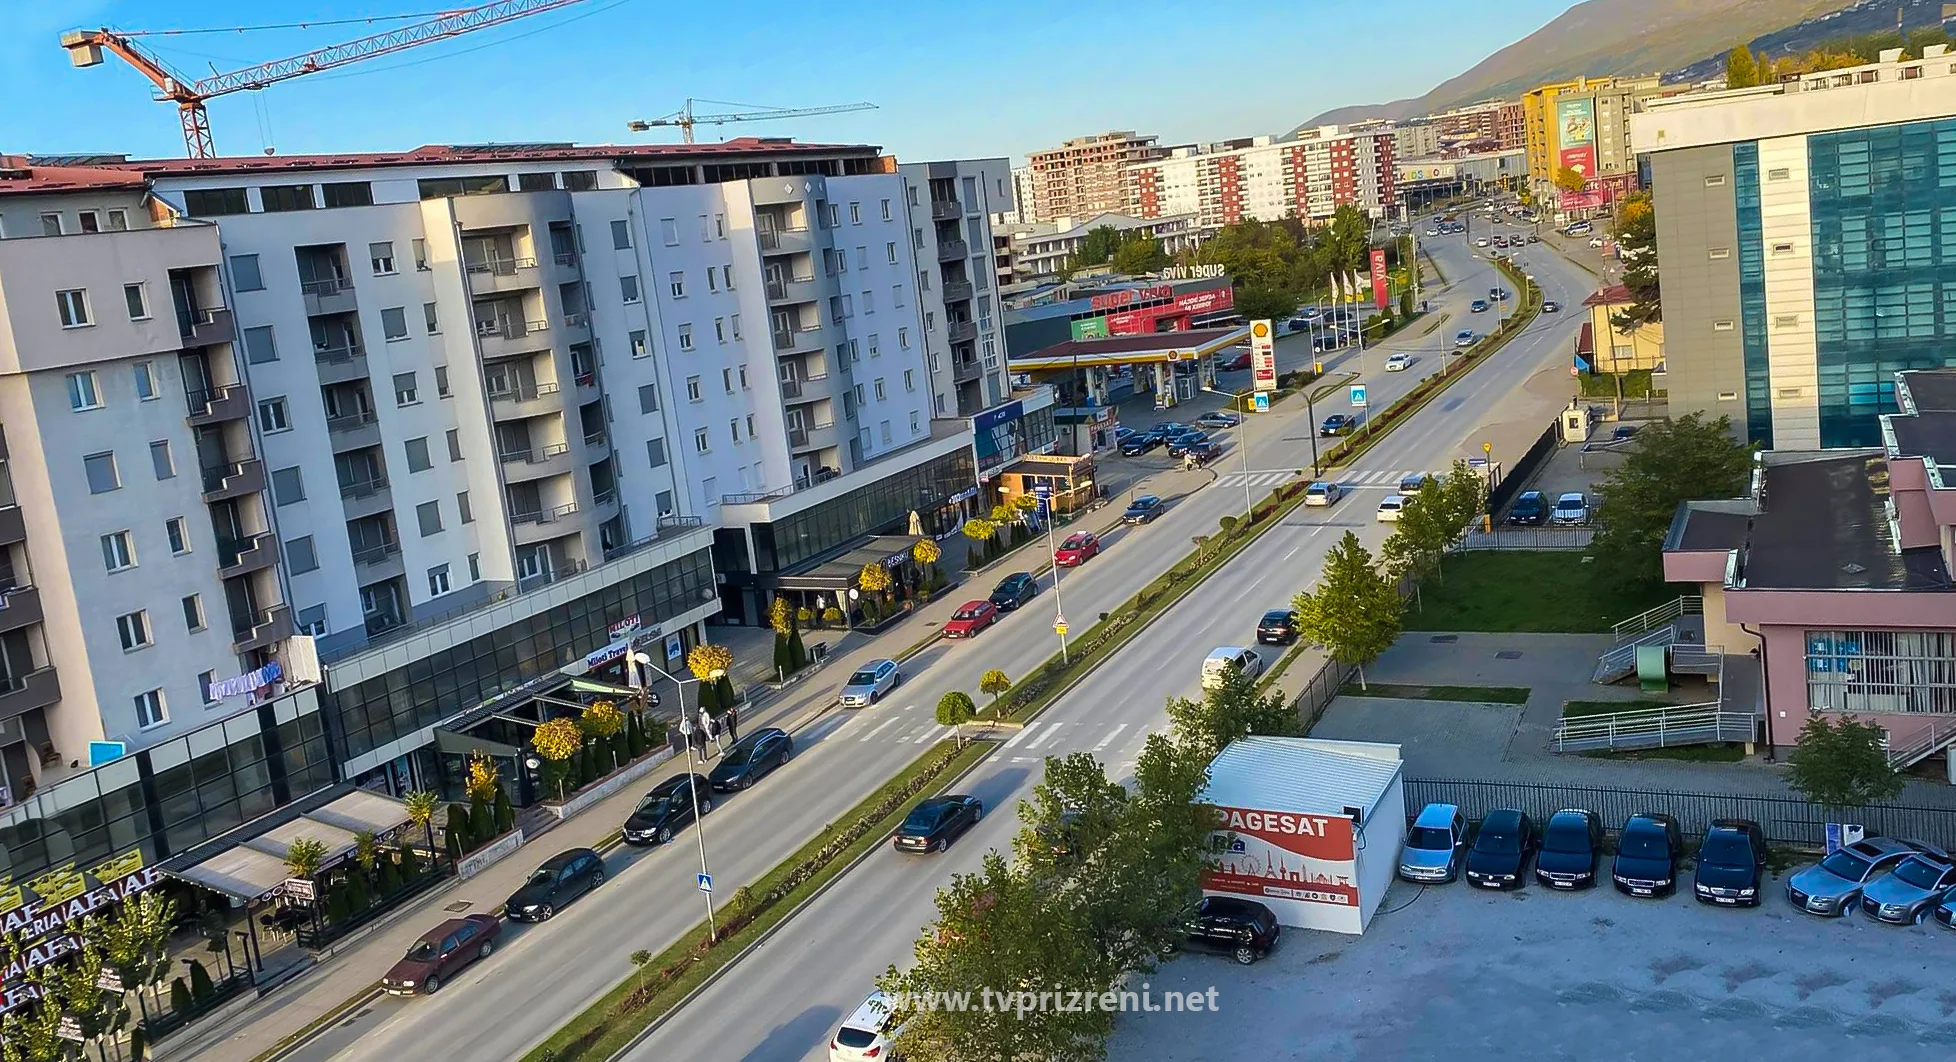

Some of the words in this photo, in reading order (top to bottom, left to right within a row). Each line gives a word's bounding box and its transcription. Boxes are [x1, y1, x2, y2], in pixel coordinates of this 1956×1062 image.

[1374, 255, 1386, 281] viva
[609, 614, 639, 633] MILOTI
[587, 652, 607, 668] Miloti
